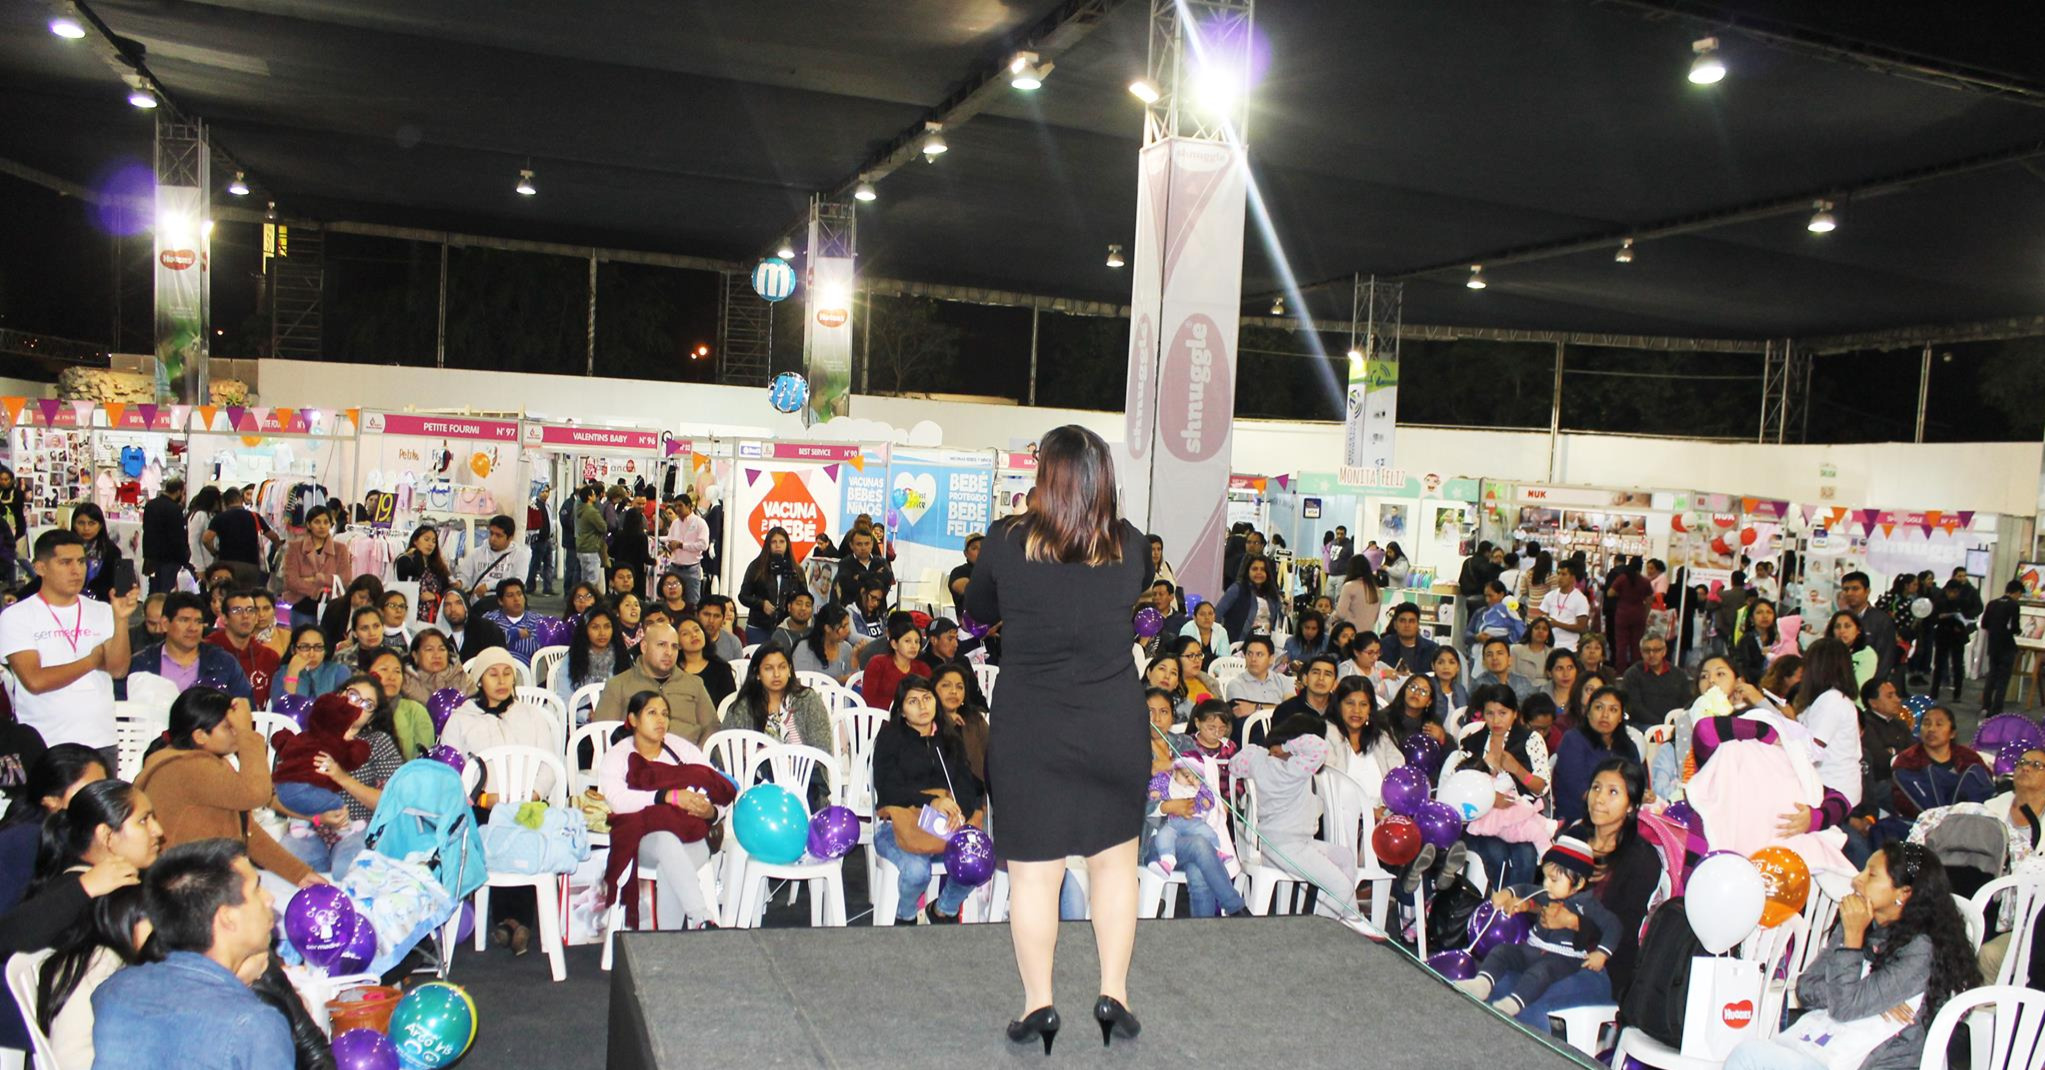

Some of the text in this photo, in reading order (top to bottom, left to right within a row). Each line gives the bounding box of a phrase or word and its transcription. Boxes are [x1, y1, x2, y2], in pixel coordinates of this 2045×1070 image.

[1181, 322, 1213, 454] shnuggle
[423, 422, 448, 432] PETITE
[448, 423, 480, 434] FOURMI
[506, 428, 516, 437] 97
[572, 432, 609, 443] VALENTINS
[609, 434, 628, 444] BABY
[647, 437, 656, 446] 96
[798, 447, 811, 456] BEST
[810, 448, 831, 457] SERVICE
[848, 476, 884, 489] VACUNAS
[949, 471, 988, 493] BEBÉ
[1340, 467, 1406, 486] MONITA FELIZ
[948, 492, 988, 503] PROTEGIDO
[1528, 490, 1546, 499] NUK
[375, 494, 393, 522] 19
[762, 500, 817, 519] VACUNA
[404, 1022, 434, 1048] Arco
